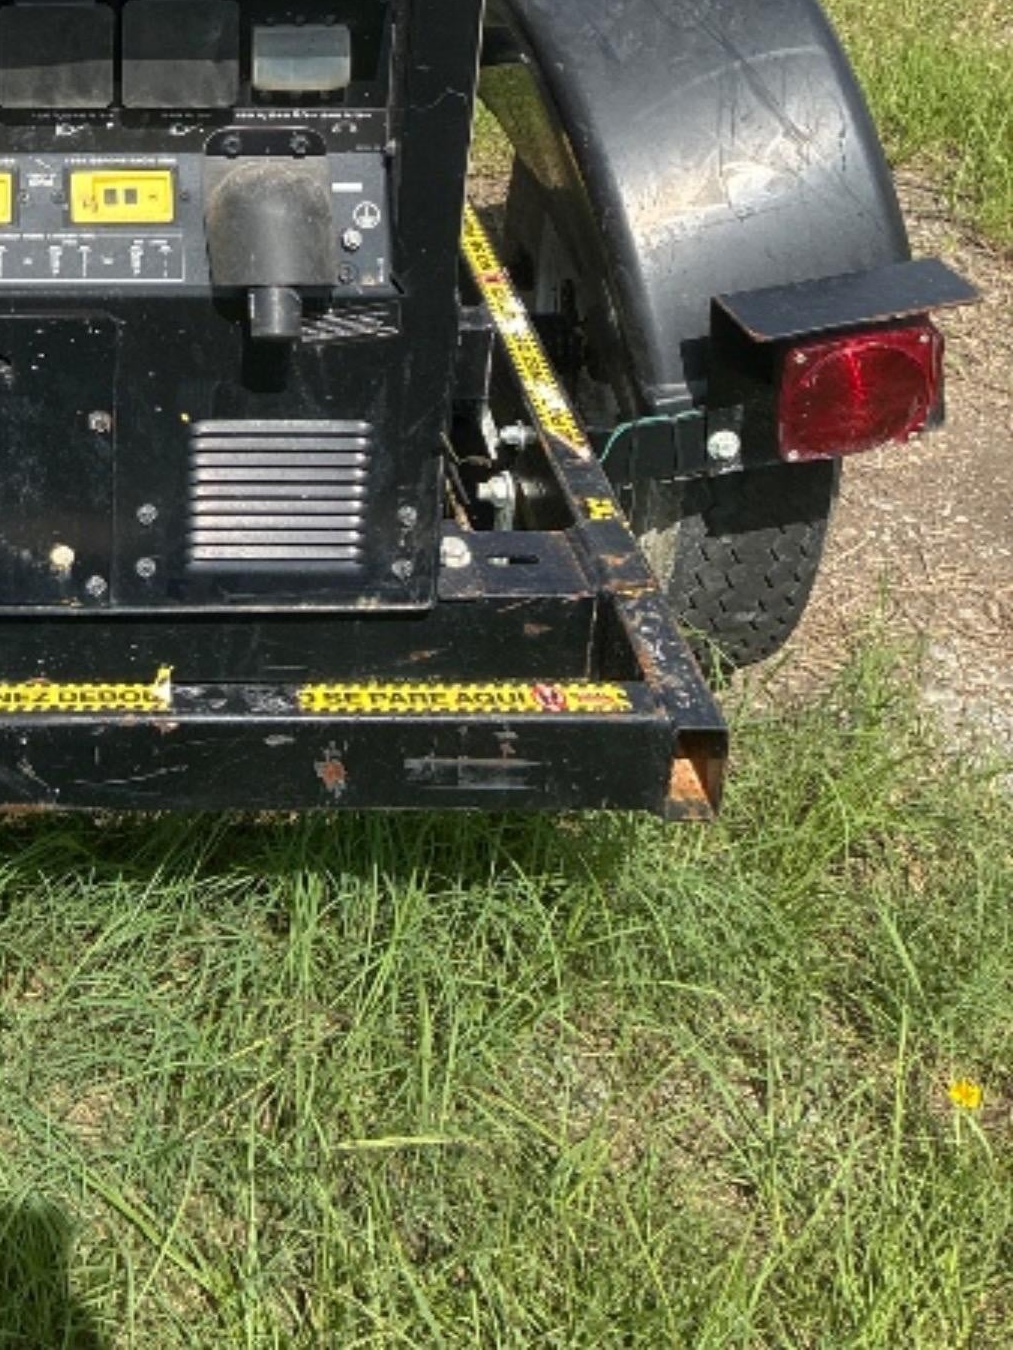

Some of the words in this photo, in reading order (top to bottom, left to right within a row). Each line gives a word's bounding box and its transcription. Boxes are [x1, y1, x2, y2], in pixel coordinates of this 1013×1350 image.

[323, 692, 362, 705] SE
[371, 692, 446, 705] PARE
[455, 692, 524, 705] AQUI
